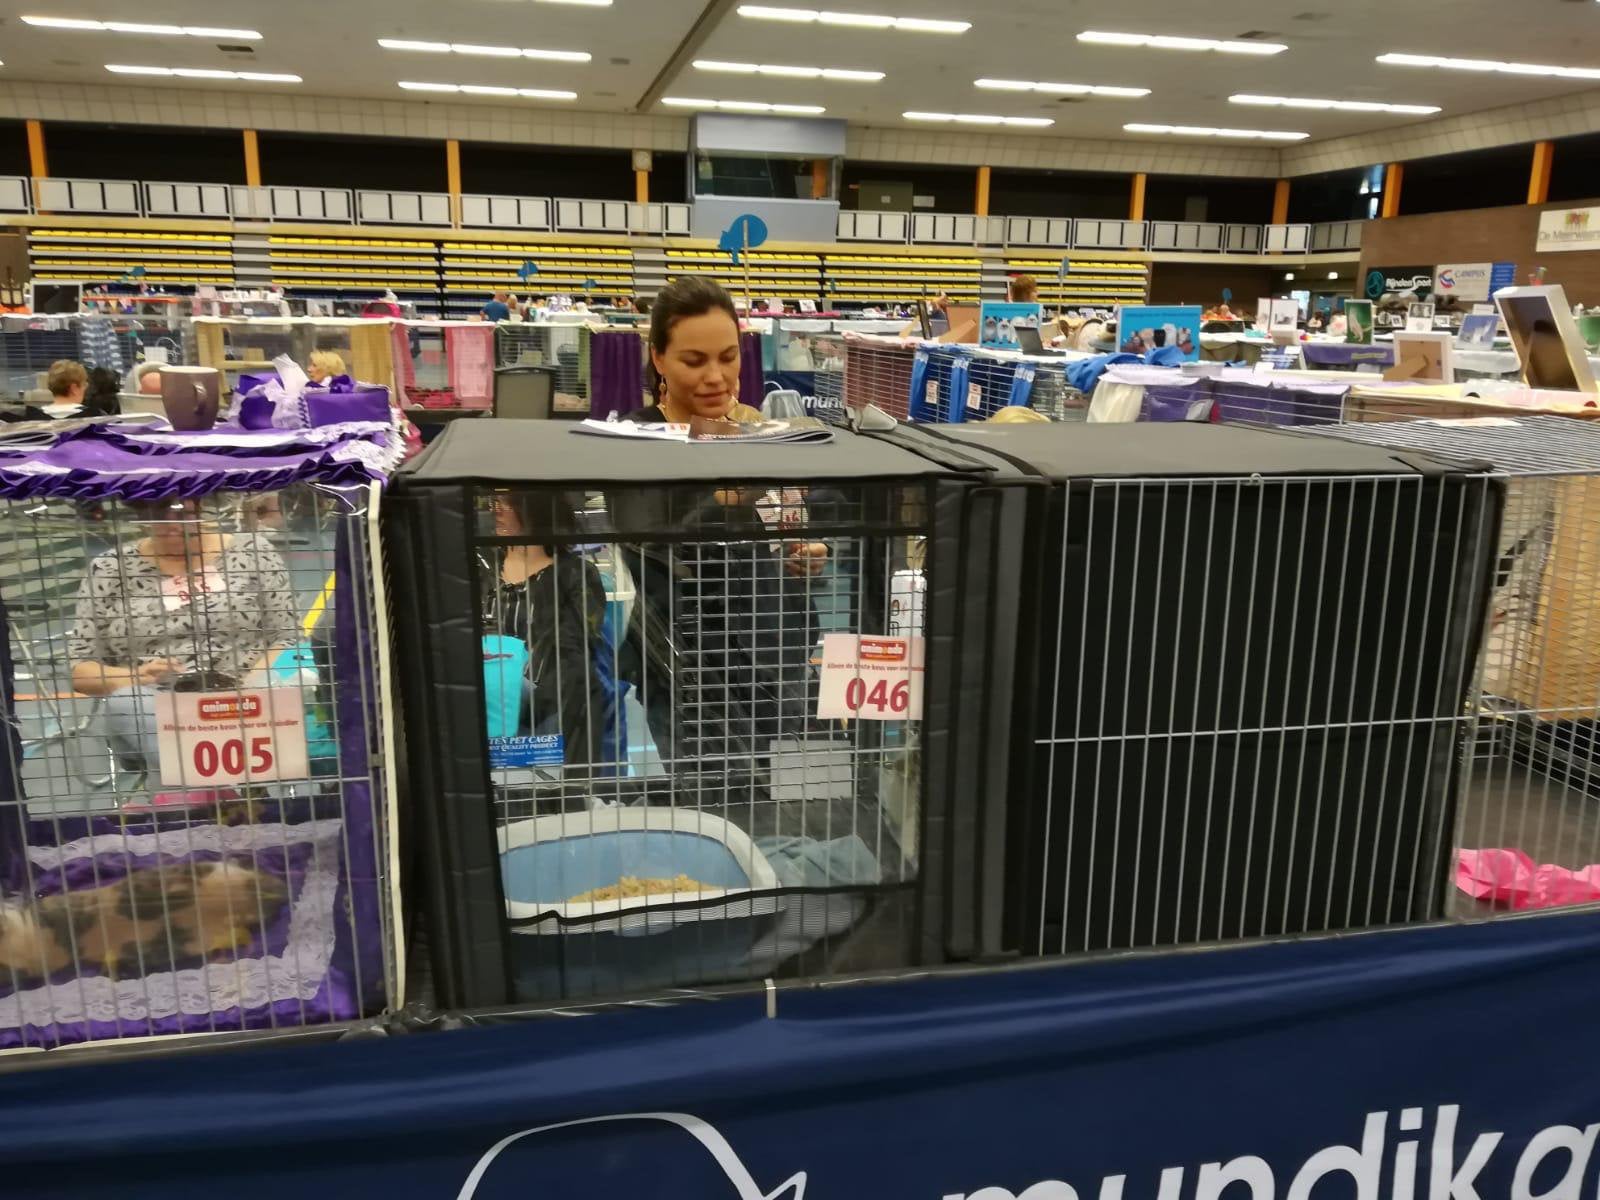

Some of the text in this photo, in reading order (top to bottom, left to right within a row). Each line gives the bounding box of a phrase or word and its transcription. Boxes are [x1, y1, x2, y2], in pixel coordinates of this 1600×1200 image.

[801, 395, 845, 409] mun
[846, 678, 909, 712] 046
[510, 736, 528, 744] PET
[528, 734, 559, 743] CAGES
[501, 743, 529, 751] QUALITY
[194, 737, 273, 777] 005
